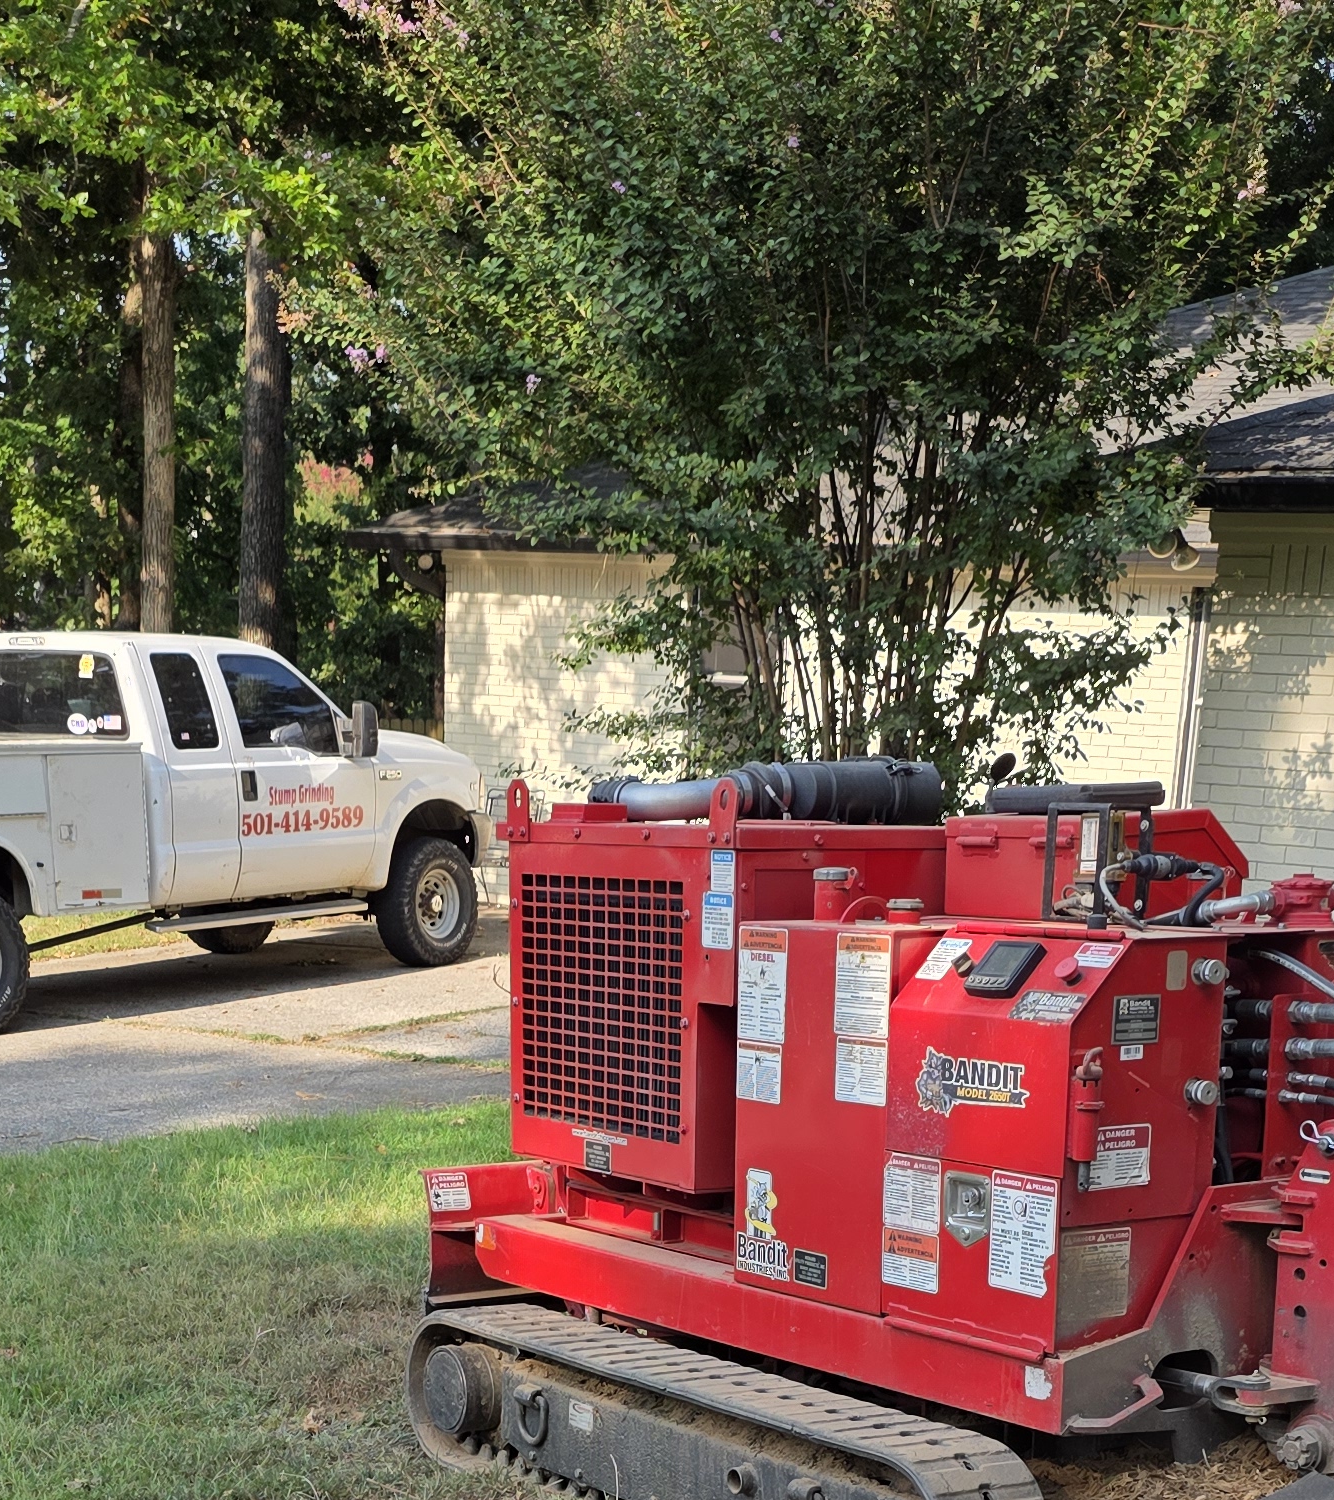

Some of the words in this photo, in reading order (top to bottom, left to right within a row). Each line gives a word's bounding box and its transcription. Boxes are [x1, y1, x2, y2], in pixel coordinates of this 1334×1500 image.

[269, 785, 296, 807] Stump
[299, 783, 335, 805] Grinding
[241, 805, 364, 836] 501-414-9589
[755, 931, 777, 939] WARNING
[750, 952, 775, 963] DIESEL
[1039, 993, 1078, 1007] Bandit
[941, 1057, 1023, 1091] BANDIT
[957, 1087, 987, 1099] MODEL
[989, 1091, 1011, 1102] 2650T
[1106, 1129, 1135, 1139] DANGER
[1105, 1140, 1136, 1149] PELIGRO
[893, 1158, 910, 1167] DANGER
[919, 1162, 938, 1172] PELIGRO
[1001, 1177, 1022, 1187] DANGER
[1032, 1183, 1054, 1192] PELIGRO
[897, 1234, 922, 1244] WARNING
[1105, 1232, 1129, 1240] PELIGRO
[738, 1233, 787, 1268] Bandit
[897, 1245, 933, 1259] ADVERTENCIA
